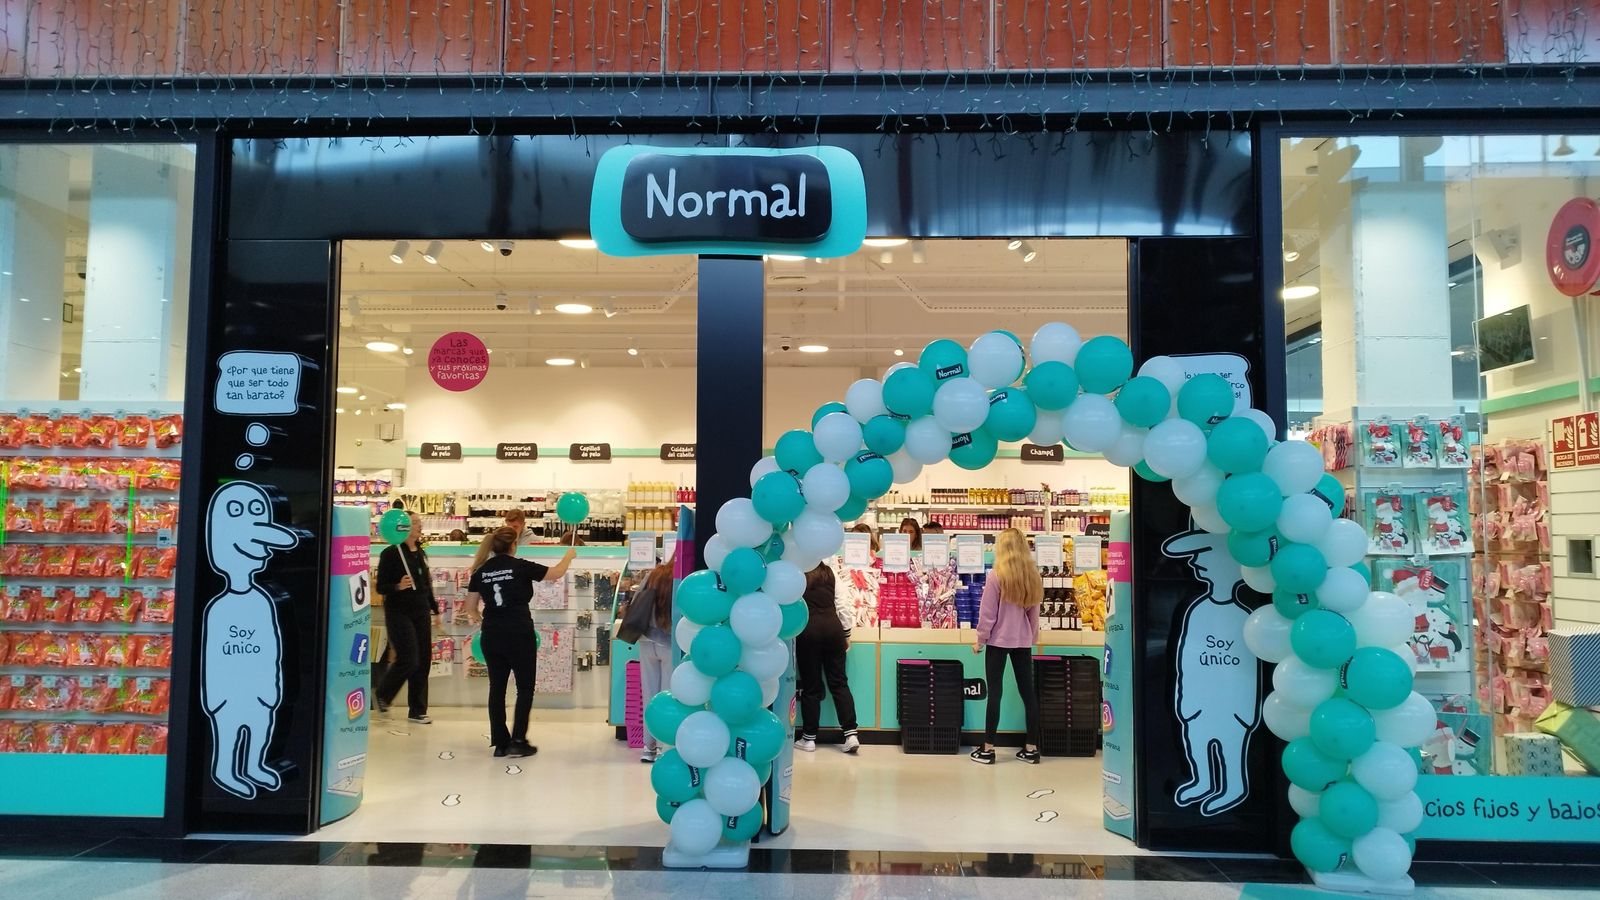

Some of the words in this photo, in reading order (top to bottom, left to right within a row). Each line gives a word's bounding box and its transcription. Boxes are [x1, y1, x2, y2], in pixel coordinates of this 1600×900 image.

[646, 168, 807, 219] Normal
[450, 338, 468, 348] Las
[433, 348, 466, 356] marcas
[469, 348, 484, 356] que
[226, 365, 249, 377] ¿Por
[251, 367, 268, 376] que
[271, 366, 295, 375] tiene
[453, 364, 487, 372] próximas
[938, 366, 961, 378] Normal
[437, 371, 480, 380] favoritas
[228, 379, 245, 388] que
[248, 379, 264, 387] ser
[267, 378, 289, 387] todo
[226, 391, 243, 400] tan
[246, 390, 285, 400] barato?
[229, 625, 256, 640] Soy
[222, 641, 261, 655] único
[1206, 635, 1234, 651] Soy
[1200, 651, 1240, 666] único
[1423, 798, 1466, 818] cios
[1473, 797, 1520, 819] fijos
[1527, 805, 1541, 822] y
